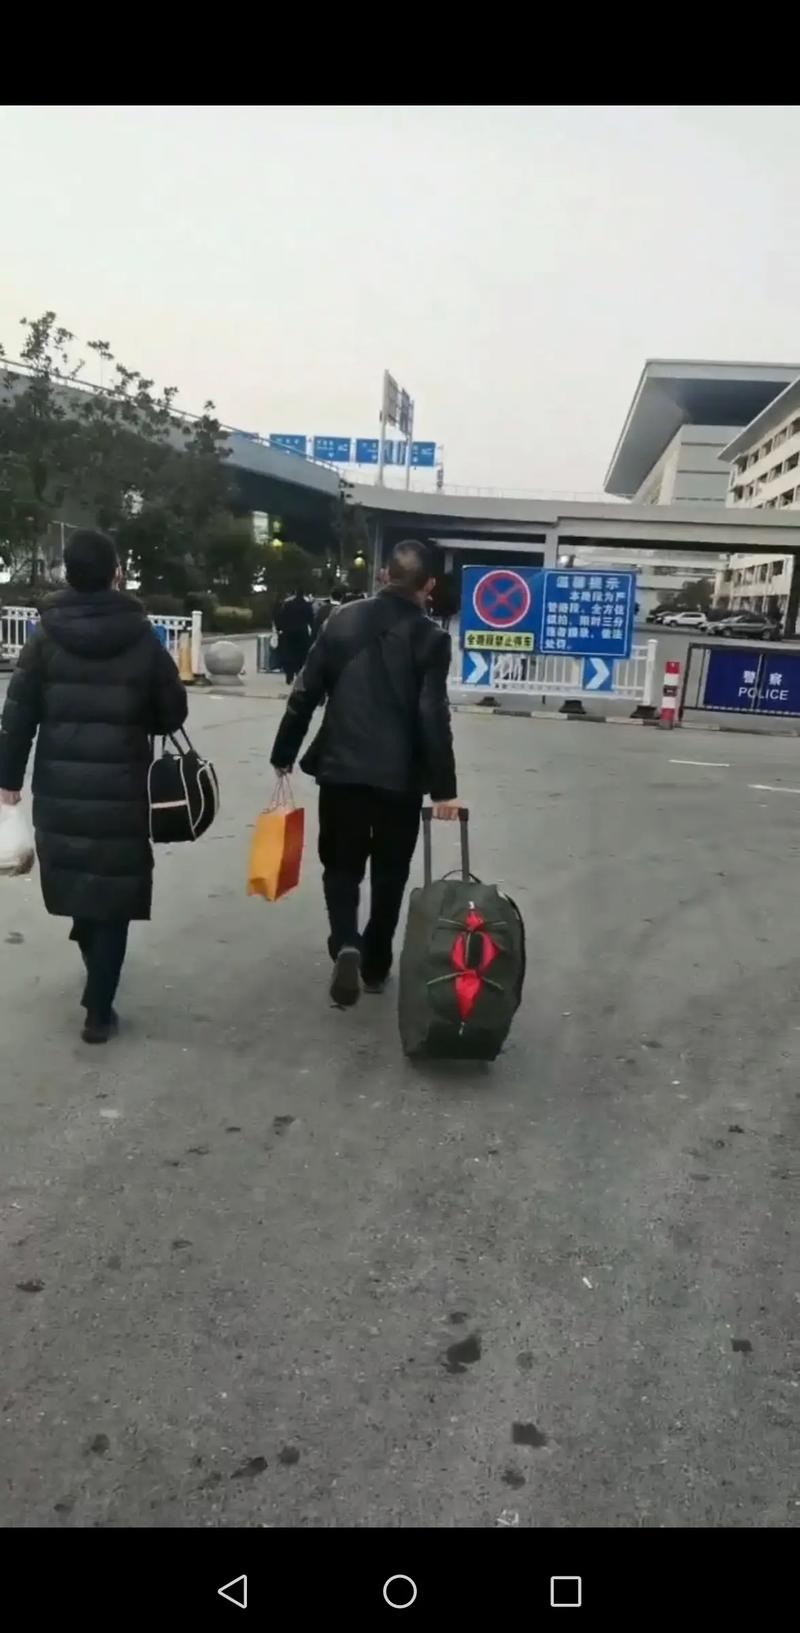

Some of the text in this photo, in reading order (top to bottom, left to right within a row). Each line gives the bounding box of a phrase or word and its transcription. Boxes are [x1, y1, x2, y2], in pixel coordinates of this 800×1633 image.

[556, 575, 620, 590] 温馨提示
[467, 633, 532, 647] 全路段禁止停车
[743, 670, 783, 686] 警察
[738, 686, 789, 700] POLICE
